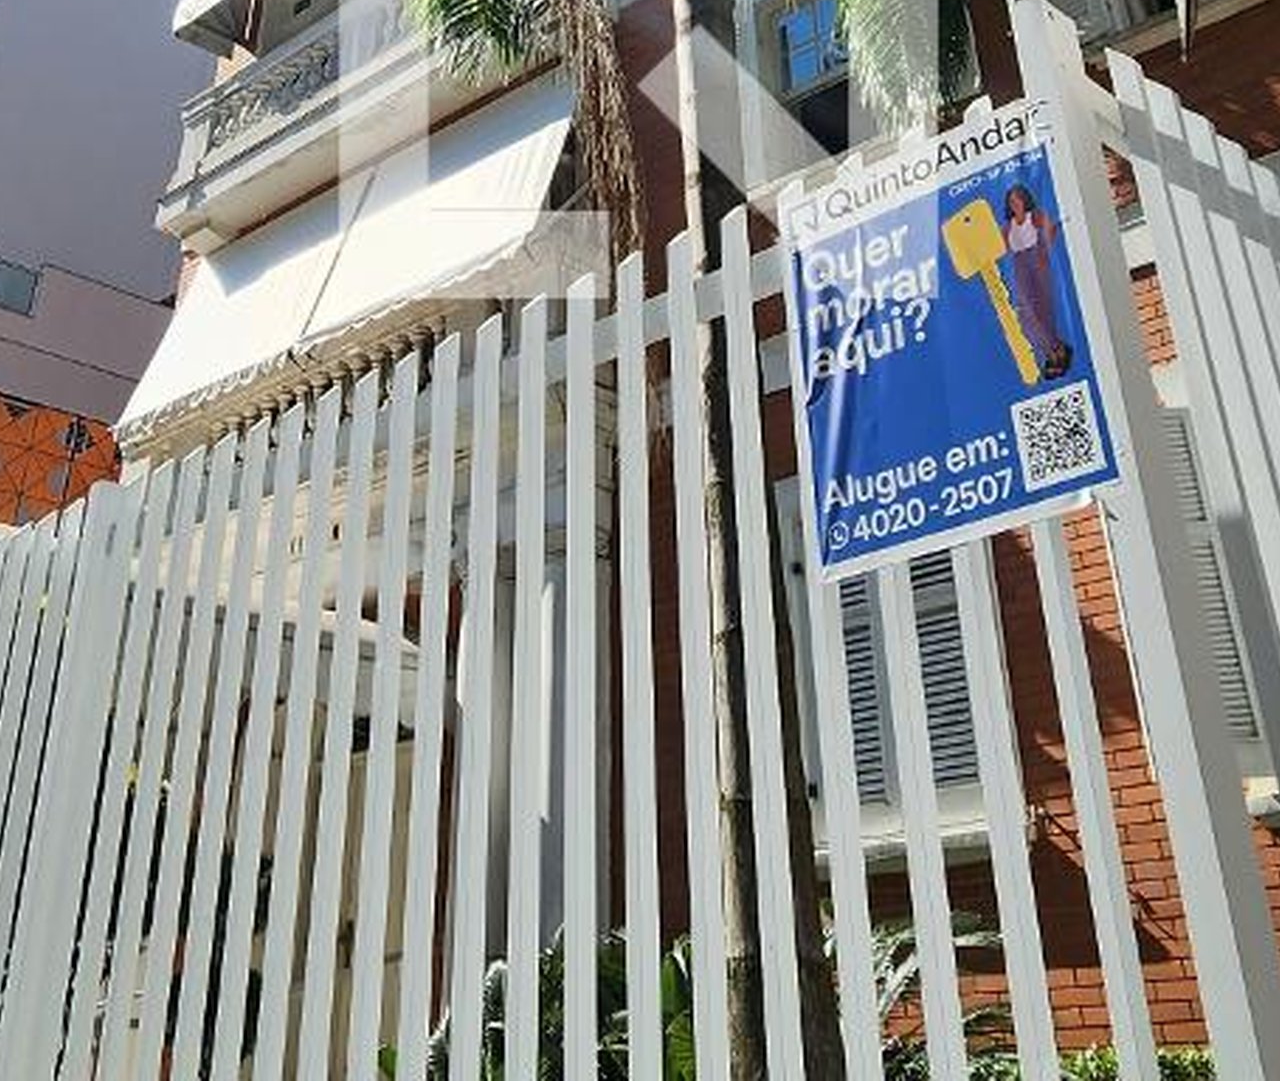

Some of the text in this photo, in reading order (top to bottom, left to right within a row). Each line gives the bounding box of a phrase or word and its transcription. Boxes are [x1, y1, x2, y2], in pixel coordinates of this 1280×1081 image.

[803, 224, 909, 293] Quer
[807, 256, 937, 334] morar
[812, 299, 932, 377] aqui?
[824, 430, 1010, 513] Alugue em:
